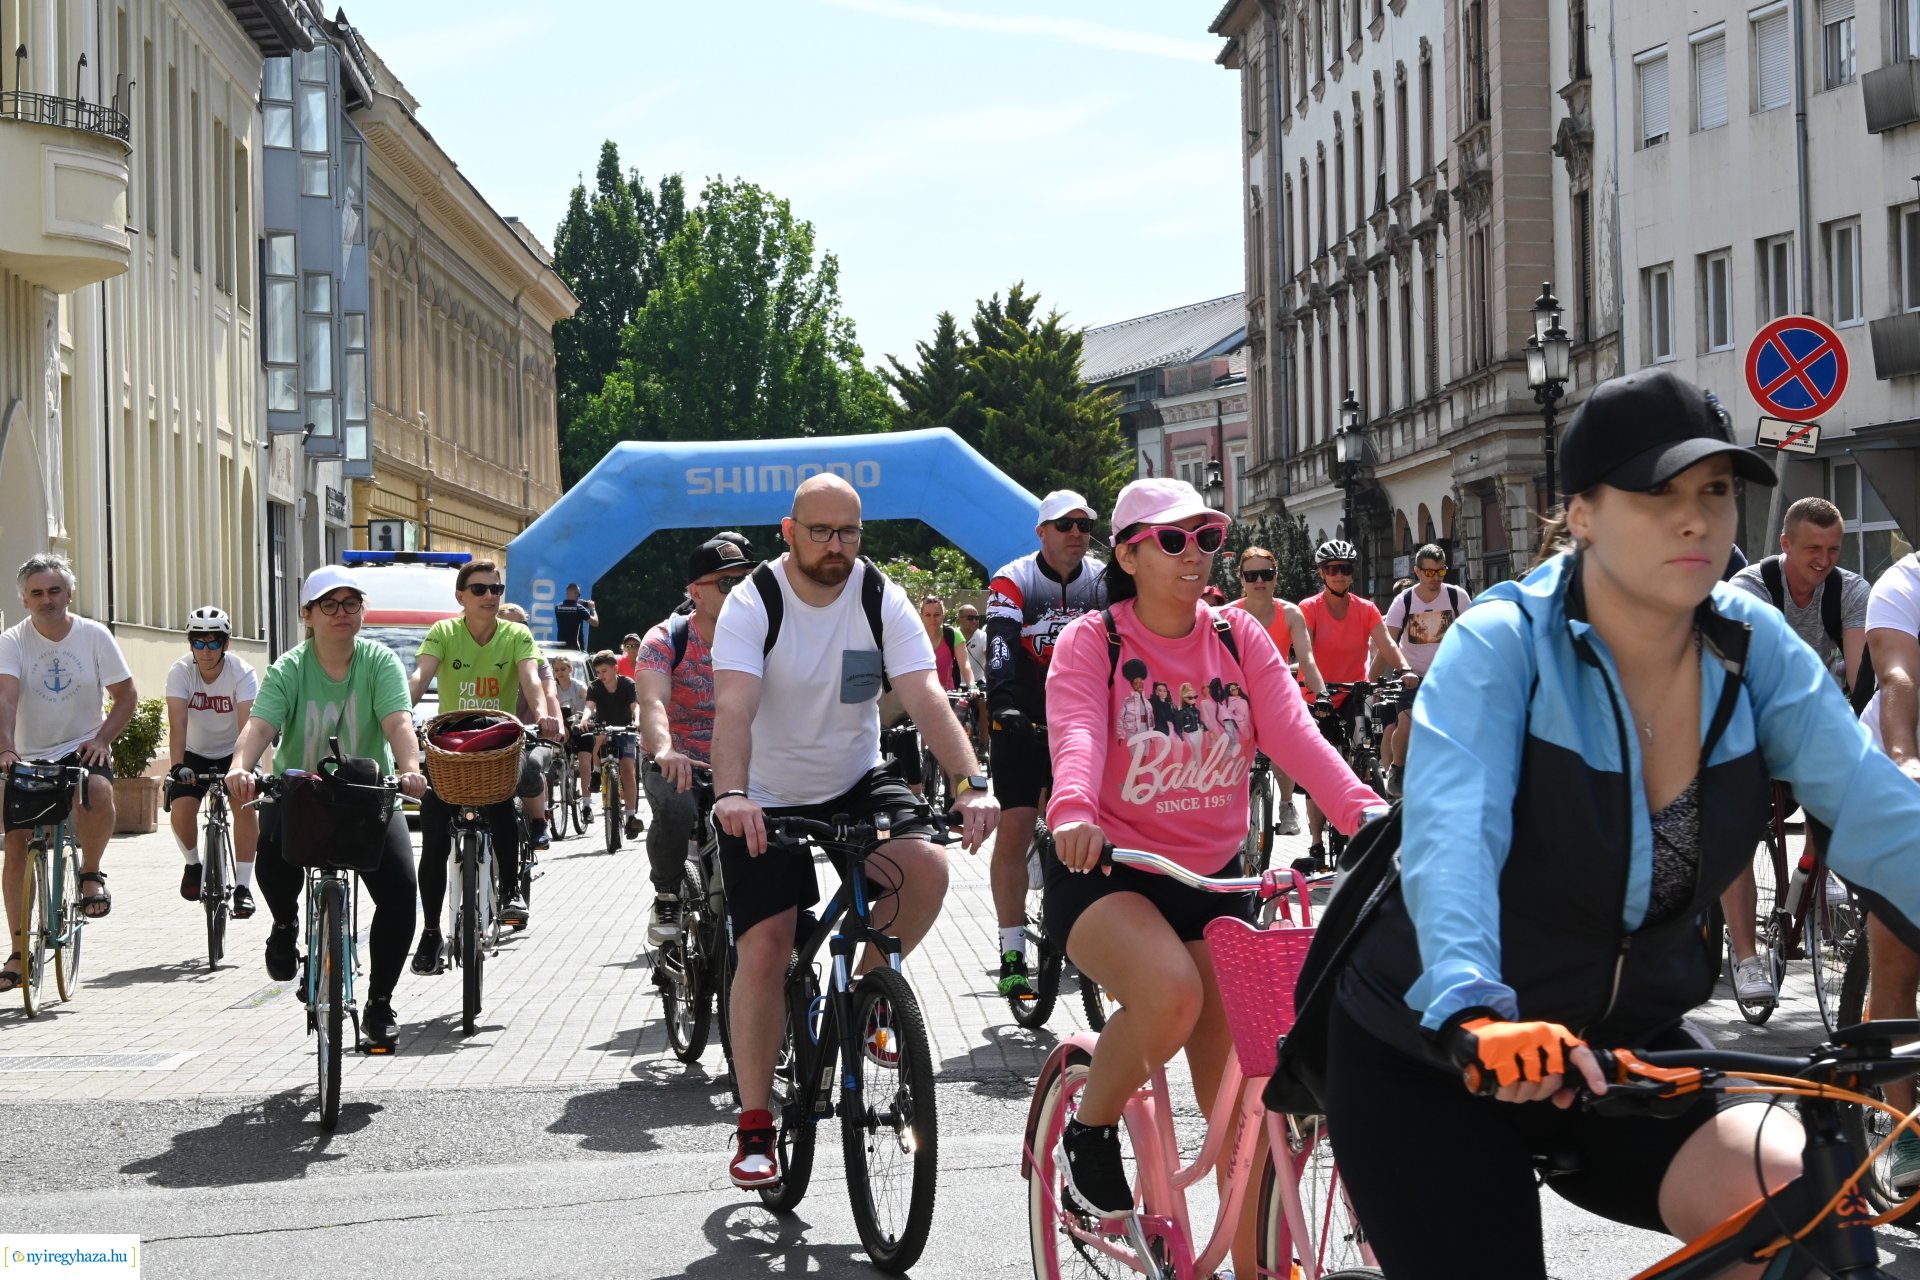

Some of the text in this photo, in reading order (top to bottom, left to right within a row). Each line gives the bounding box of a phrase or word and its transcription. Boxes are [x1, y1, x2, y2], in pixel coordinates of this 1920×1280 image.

[1121, 730, 1250, 805] Barbie
[1155, 793, 1233, 814] SINCE 1959
